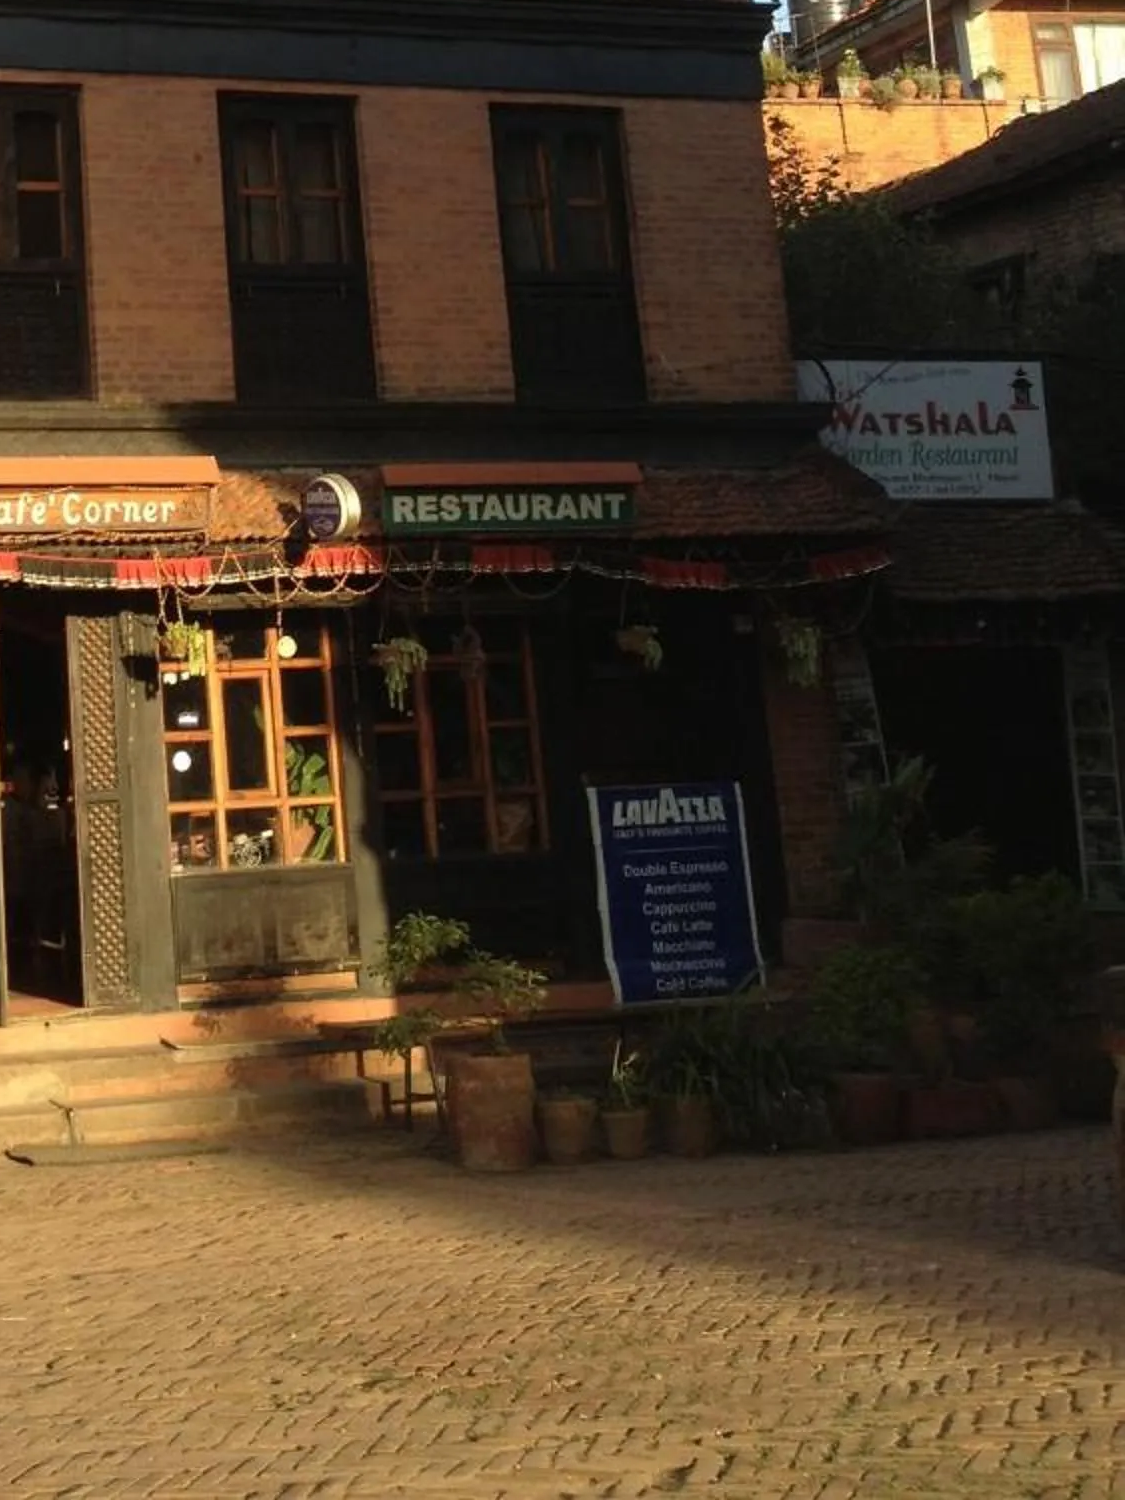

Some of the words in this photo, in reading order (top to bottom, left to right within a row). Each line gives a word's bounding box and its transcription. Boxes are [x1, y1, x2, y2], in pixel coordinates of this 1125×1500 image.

[908, 440, 1019, 470] Restaurant
[62, 493, 176, 525] Corner
[392, 493, 626, 524] RESTAURANT
[612, 787, 727, 827] LAVAZZA
[623, 863, 667, 877] Double
[669, 861, 729, 876] Espresso
[644, 882, 713, 895] Americano
[642, 901, 717, 916] Cappuccino
[656, 978, 686, 991] Cold
[689, 976, 729, 989] Coffee
